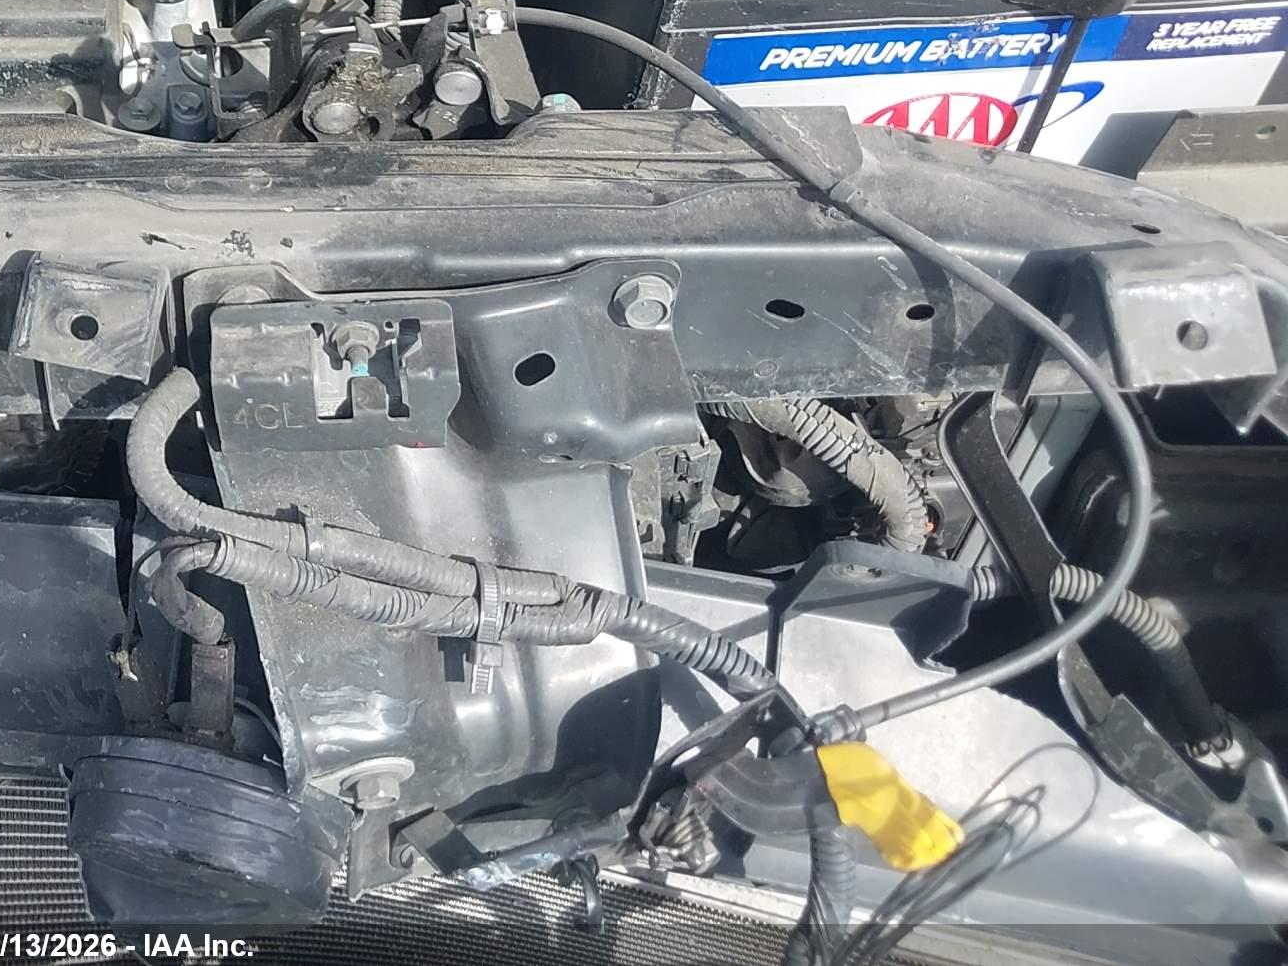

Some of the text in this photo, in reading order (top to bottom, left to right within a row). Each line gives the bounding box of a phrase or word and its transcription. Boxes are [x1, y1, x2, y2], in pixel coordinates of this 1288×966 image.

[1153, 16, 1282, 38] 3 YEAR FREE
[759, 31, 1067, 72] PREMIUM BATTERY
[1145, 32, 1273, 52] REPLACEMENT
